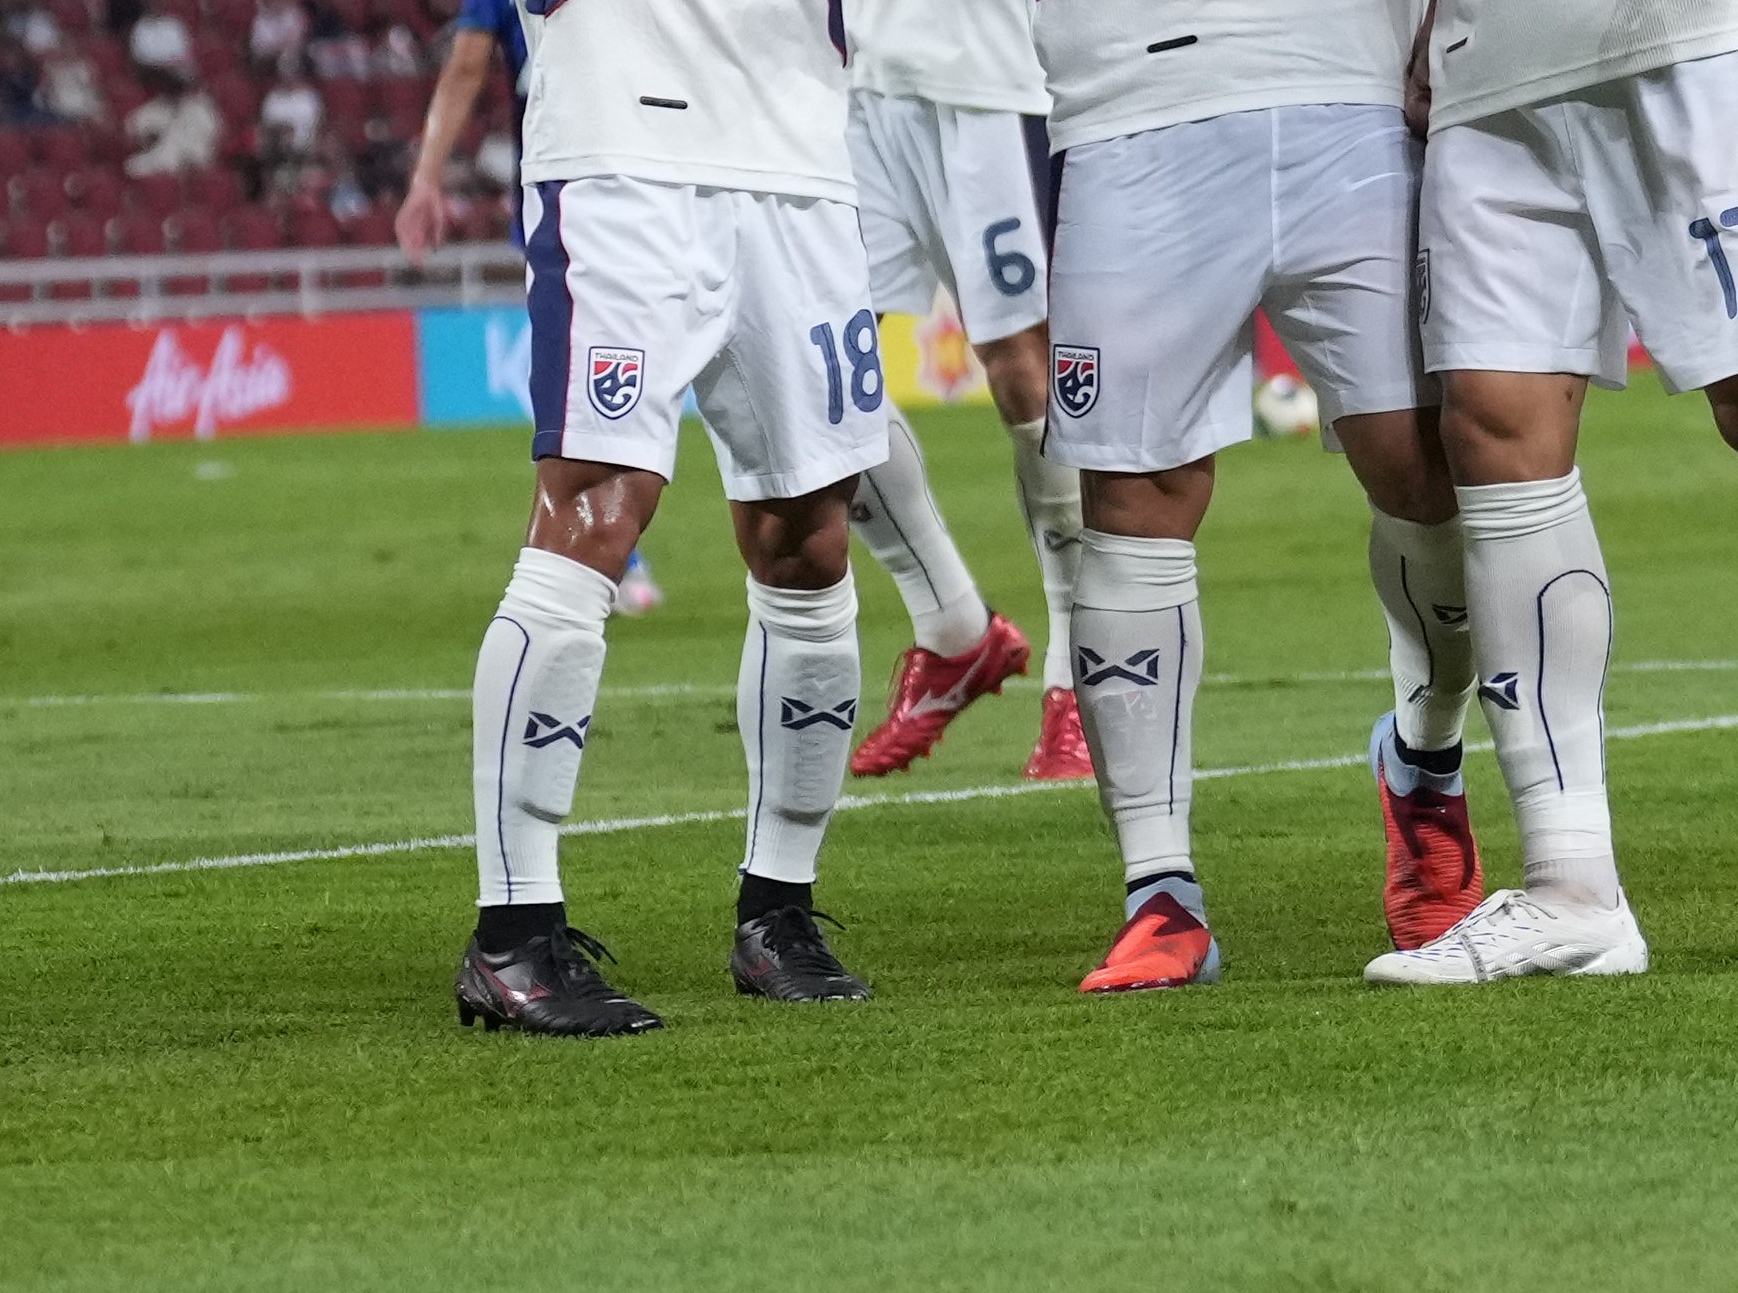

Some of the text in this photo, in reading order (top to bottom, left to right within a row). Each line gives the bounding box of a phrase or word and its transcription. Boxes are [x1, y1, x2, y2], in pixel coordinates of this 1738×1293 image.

[982, 217, 1036, 297] 6
[595, 352, 639, 362] THAILAND
[810, 308, 883, 425] 18
[1058, 350, 1095, 361] THAILAND
